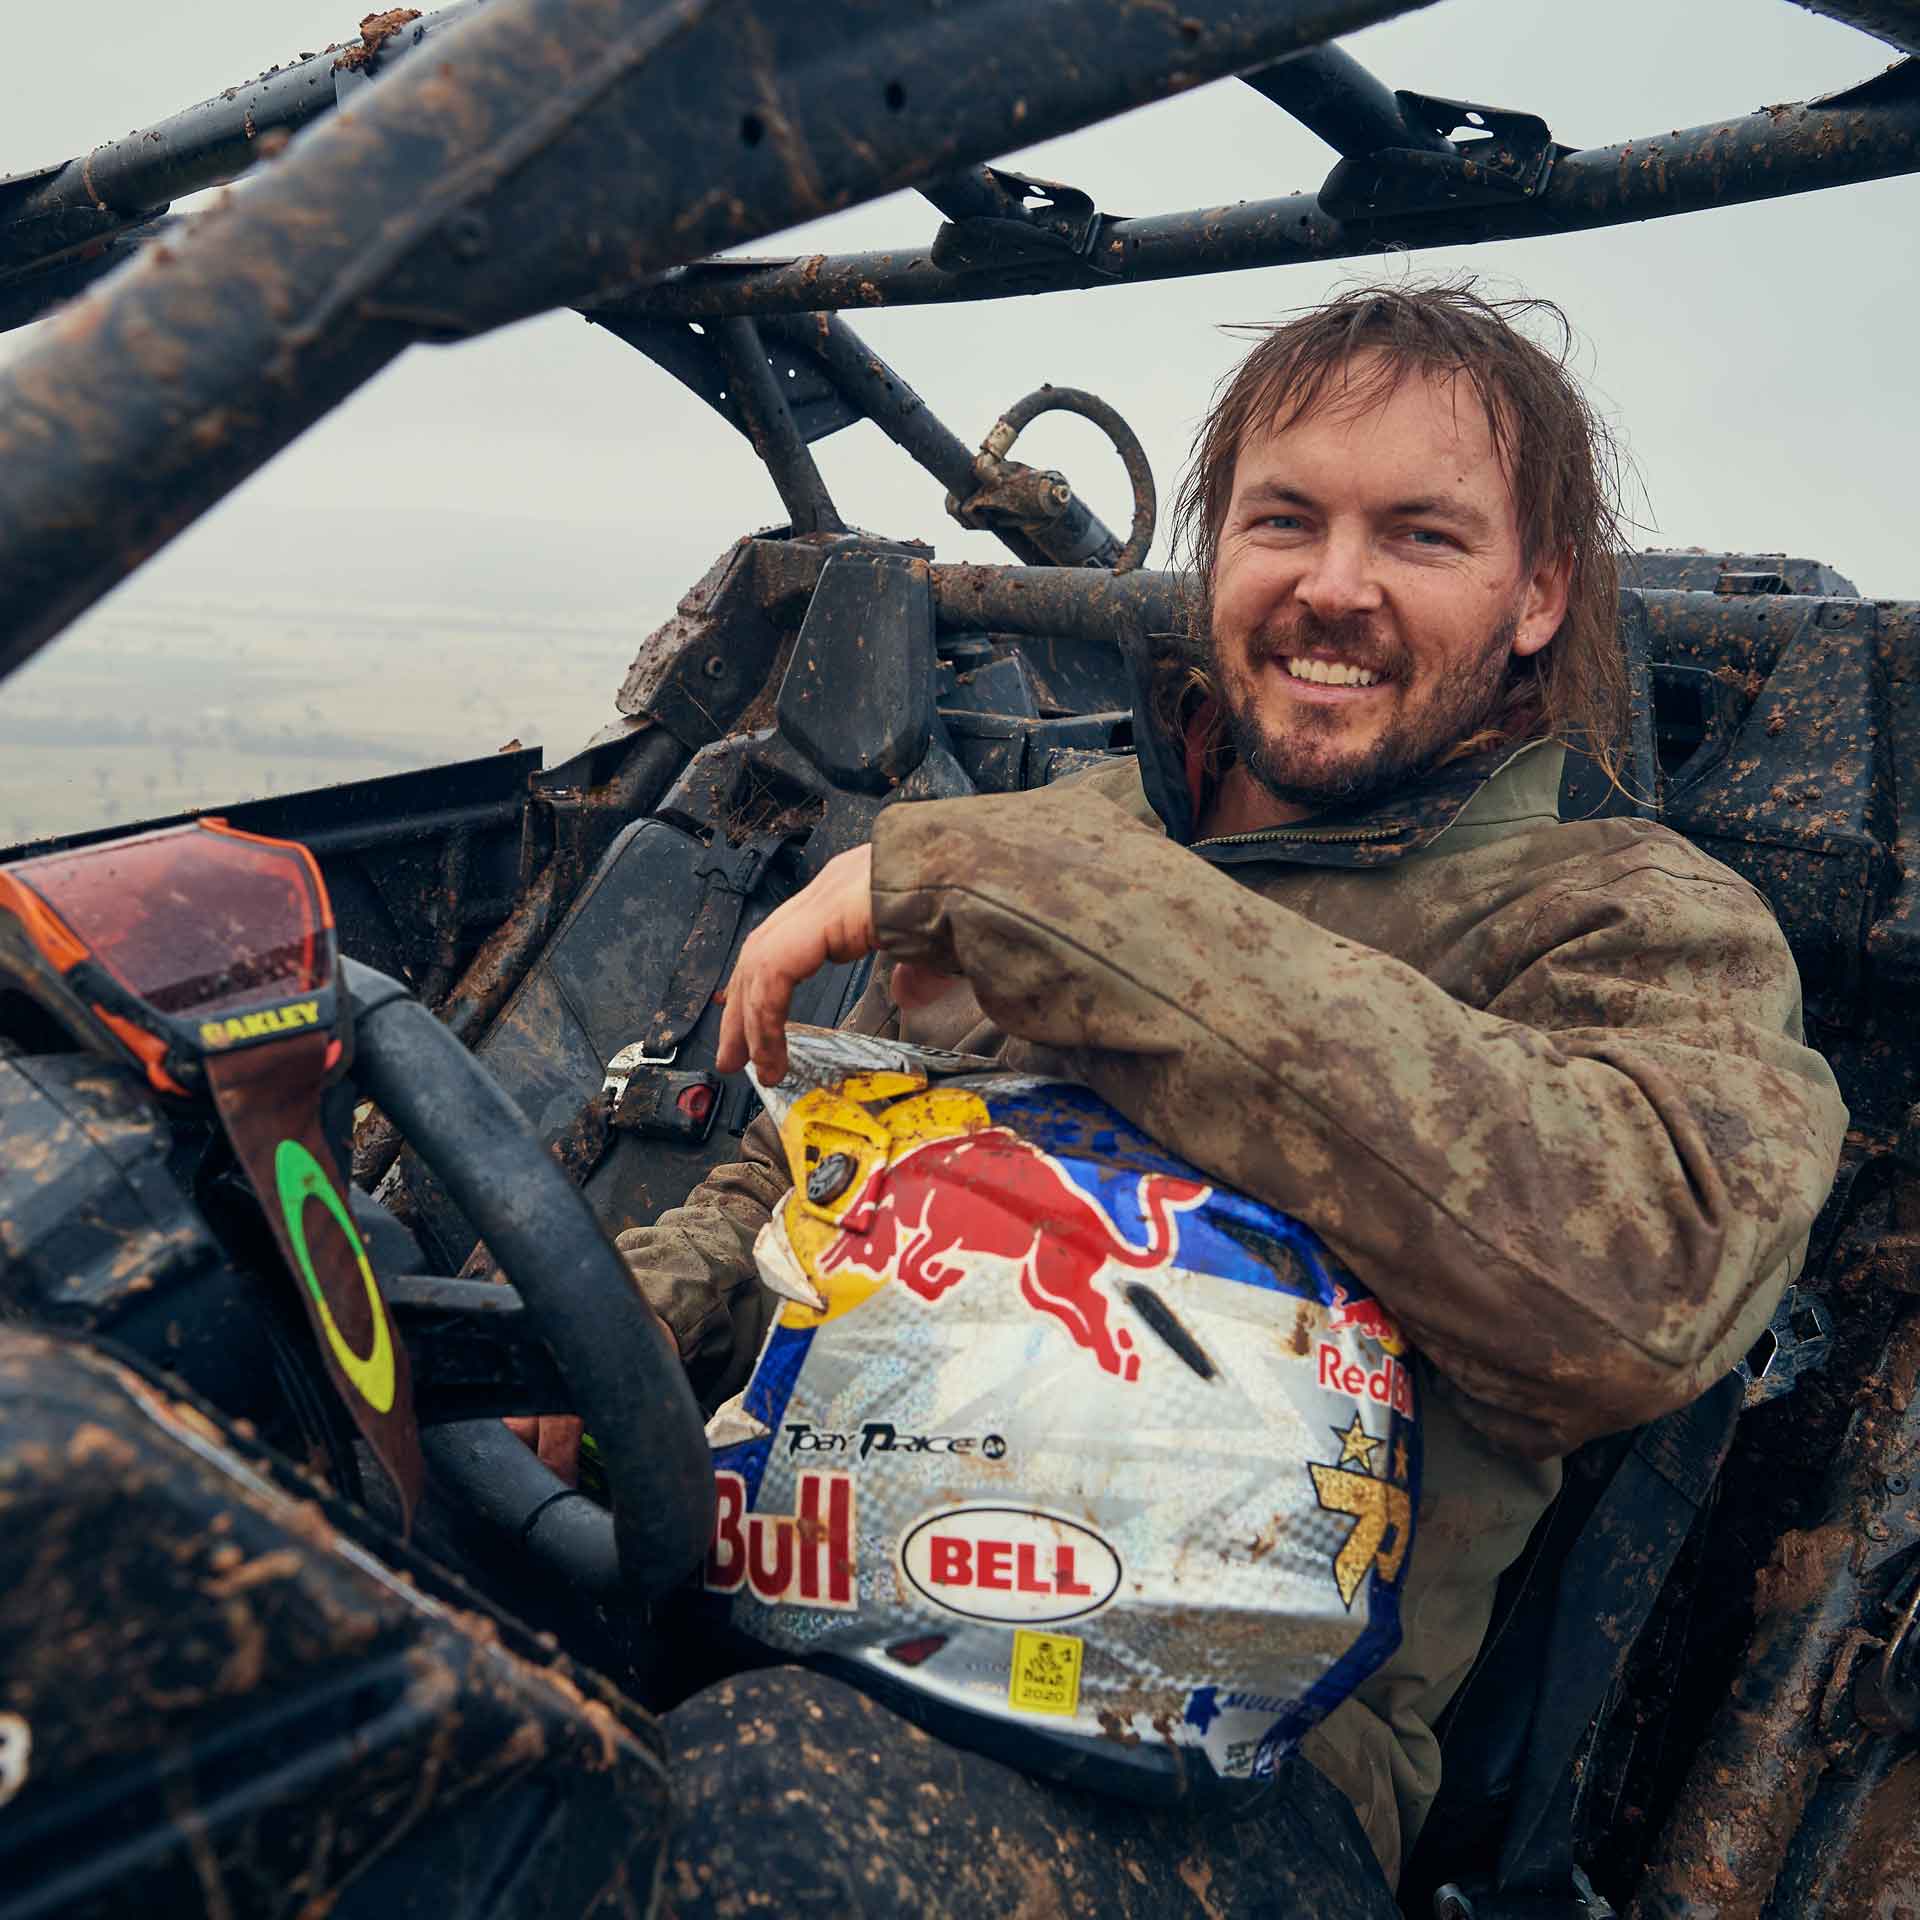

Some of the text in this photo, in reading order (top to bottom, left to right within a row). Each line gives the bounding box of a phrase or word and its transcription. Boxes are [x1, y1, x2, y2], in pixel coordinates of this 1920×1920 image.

[201, 1001, 319, 1047] OAKLEY
[704, 1472, 855, 1608] Bull
[930, 1536, 1091, 1596] BELL
[1023, 1688, 1065, 1702] 2020
